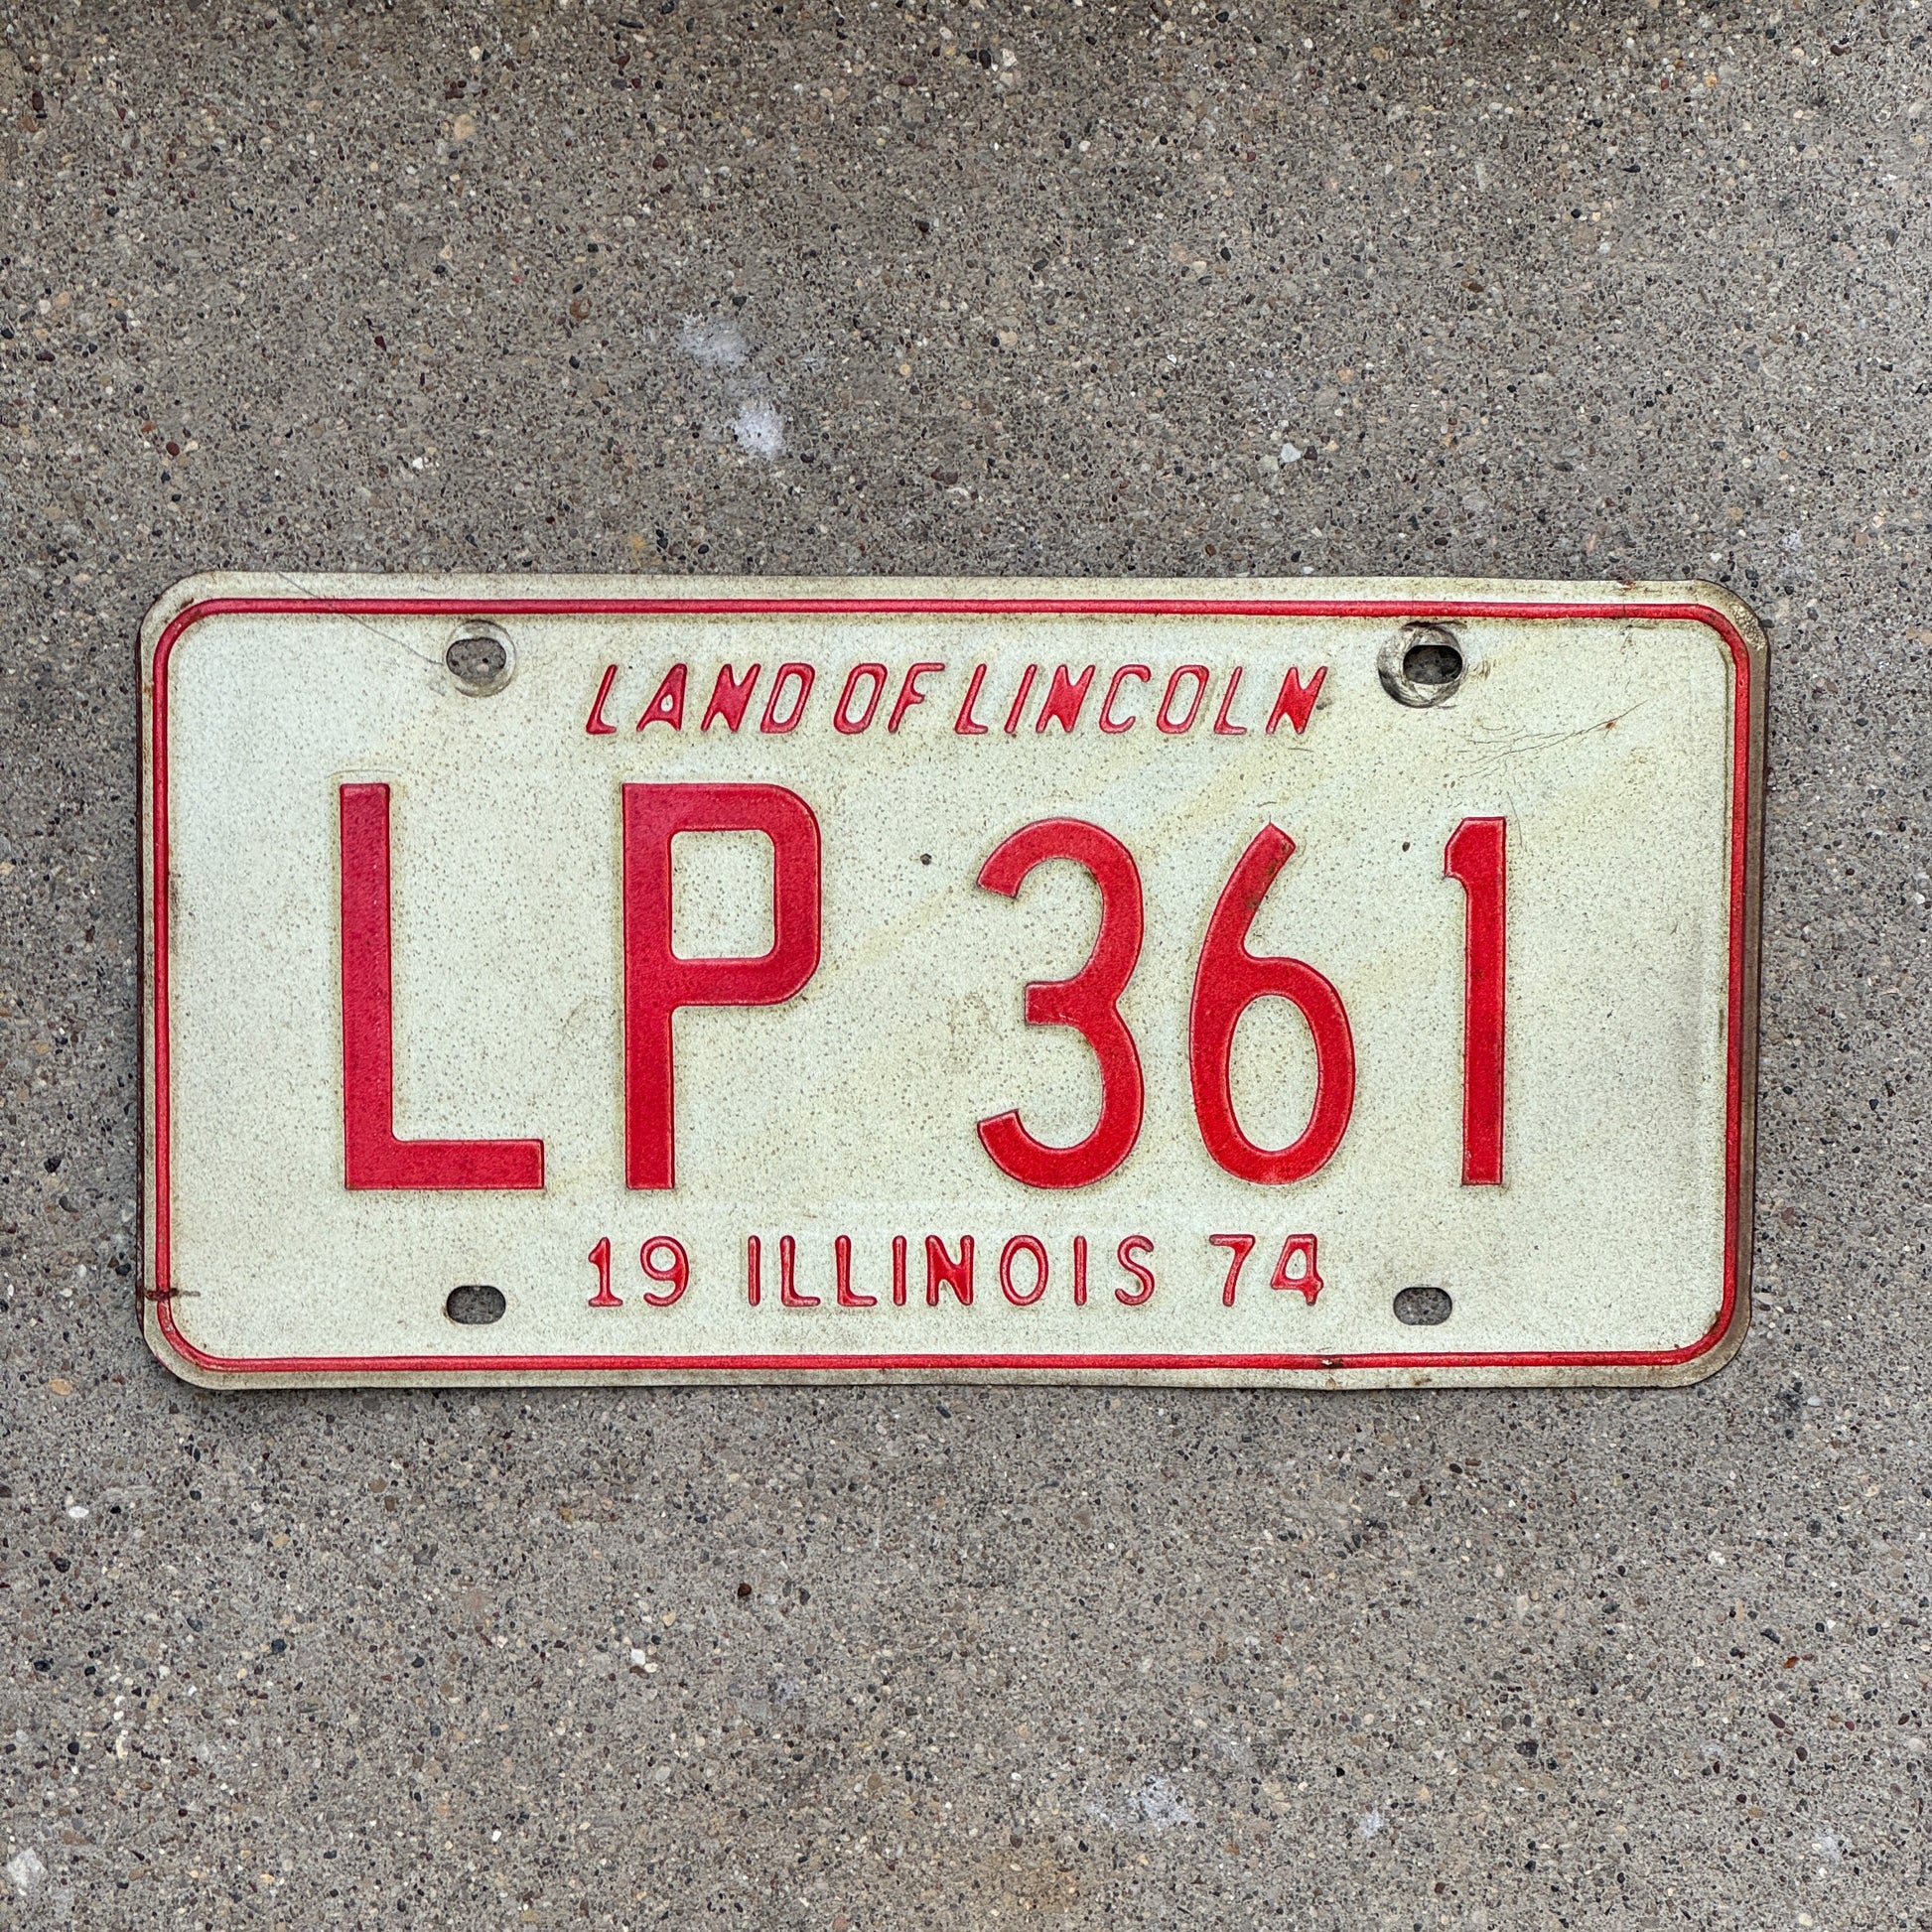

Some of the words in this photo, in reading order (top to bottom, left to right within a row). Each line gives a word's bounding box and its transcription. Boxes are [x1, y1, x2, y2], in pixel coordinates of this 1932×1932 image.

[586, 662, 816, 735] LAND
[833, 661, 944, 735] OF
[954, 664, 1326, 735] LINCOLN
[340, 782, 822, 1191] LP
[976, 816, 1507, 1190] 361
[587, 1235, 690, 1309] 19
[748, 1234, 1156, 1308] ILLINOIS
[1211, 1233, 1324, 1308] 74
